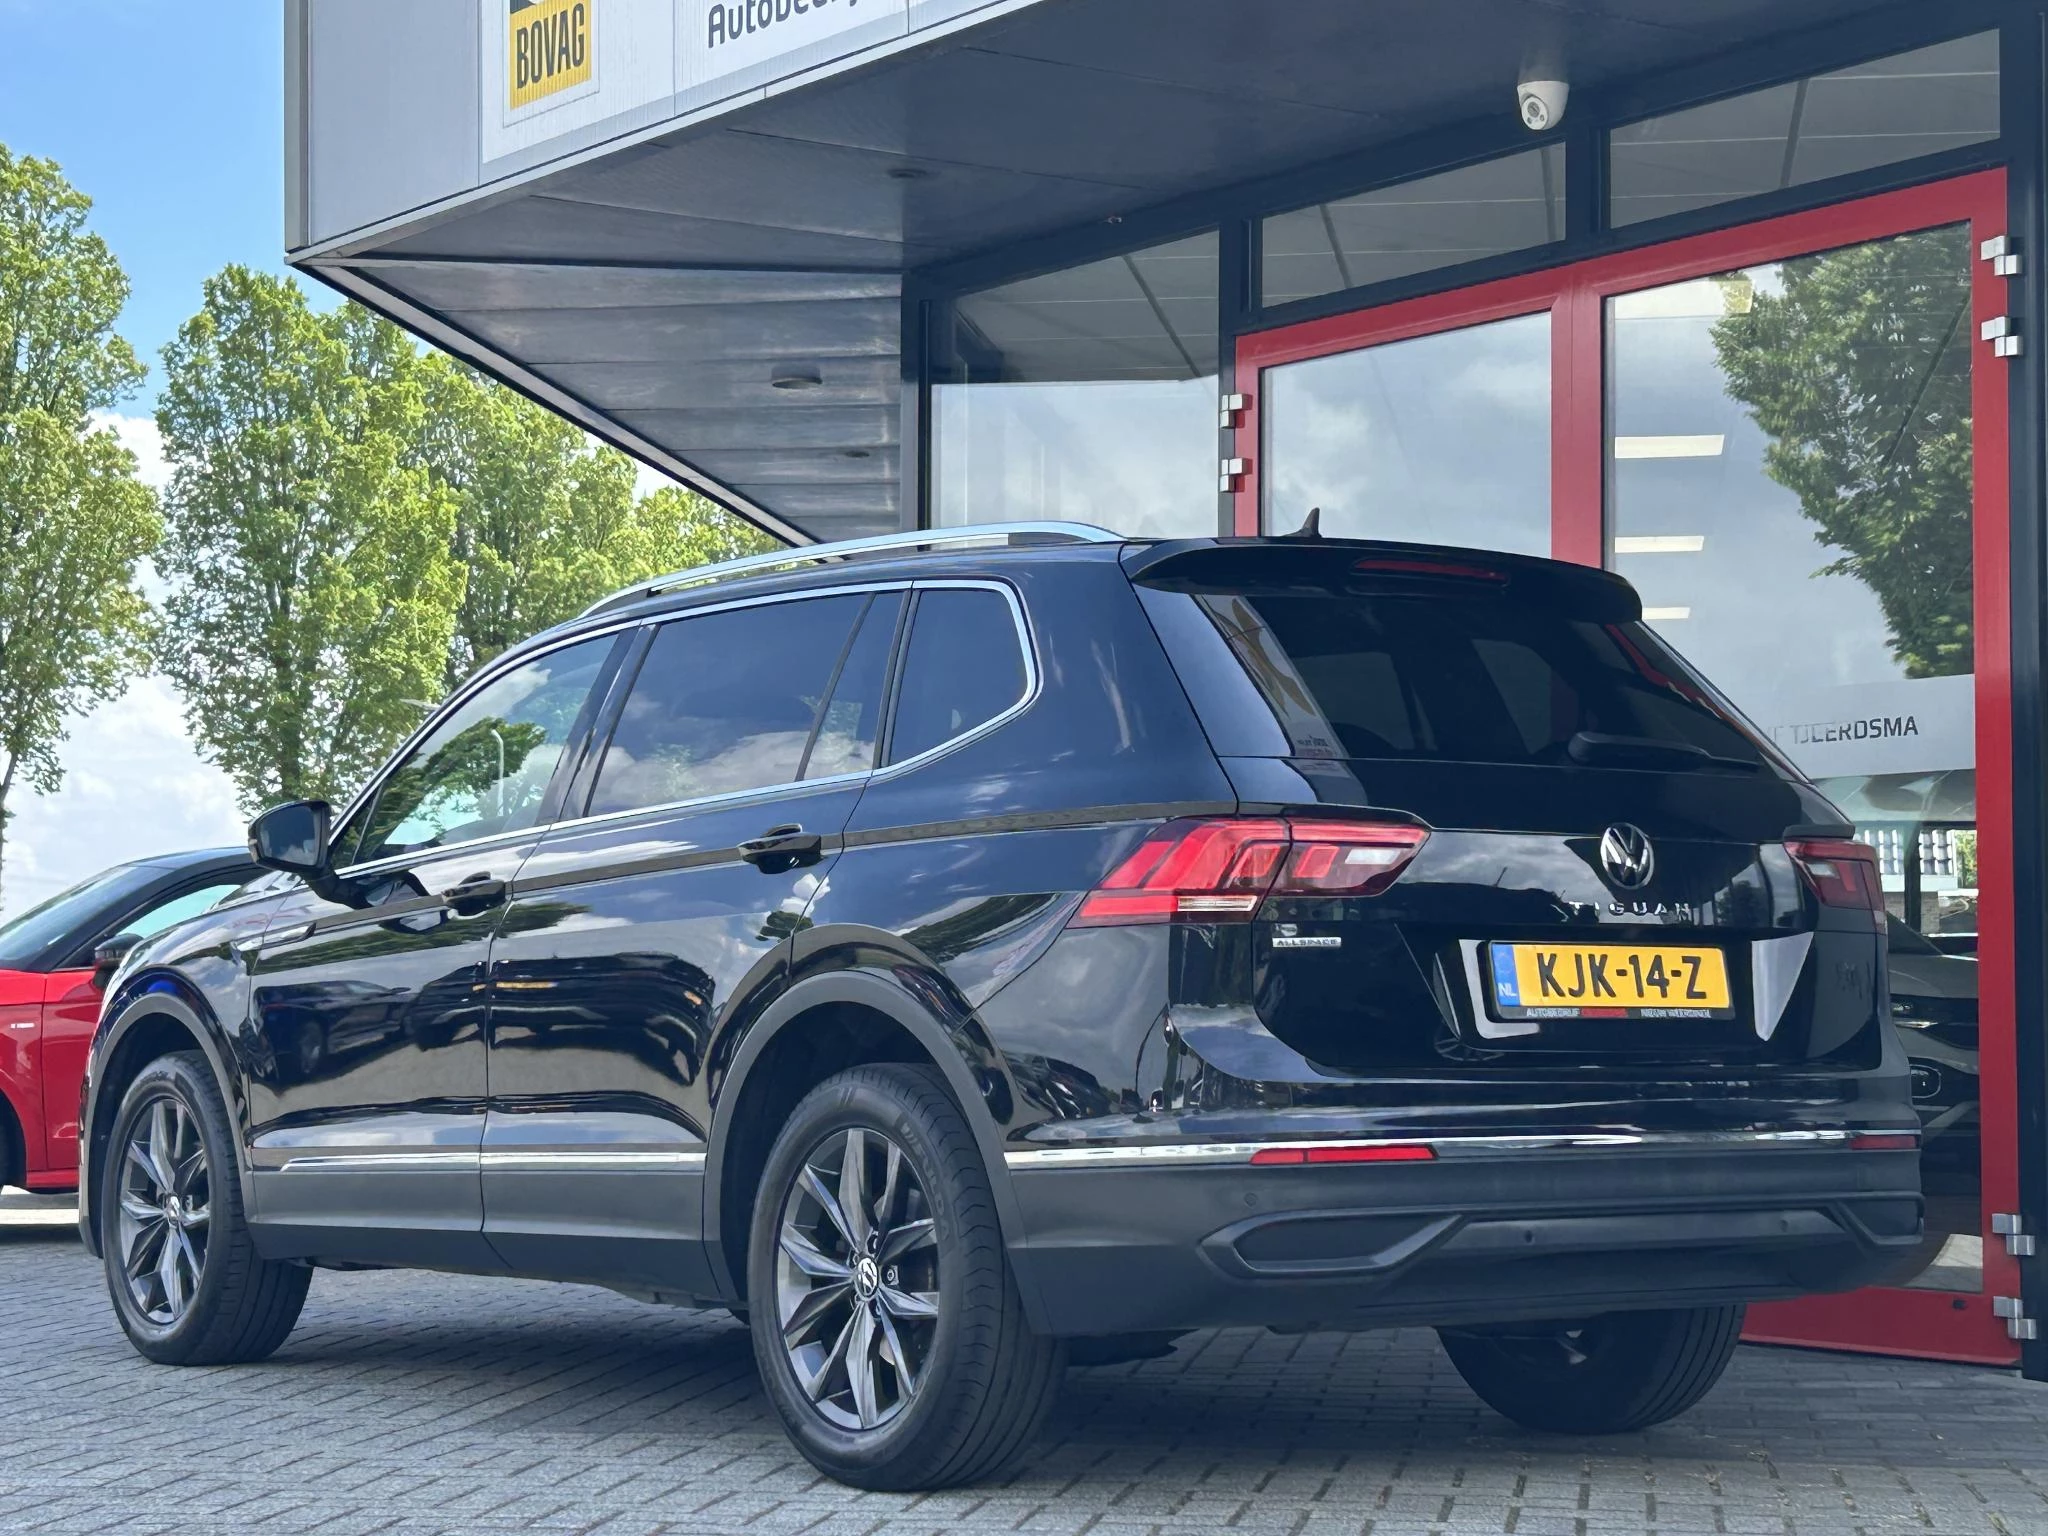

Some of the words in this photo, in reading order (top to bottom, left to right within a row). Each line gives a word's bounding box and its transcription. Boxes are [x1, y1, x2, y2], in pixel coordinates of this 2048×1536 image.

[516, 2, 585, 89] BOVAG
[1568, 901, 1692, 919] TIGUAN
[1498, 983, 1516, 997] NL
[1536, 952, 1707, 999] KJK-14-Z
